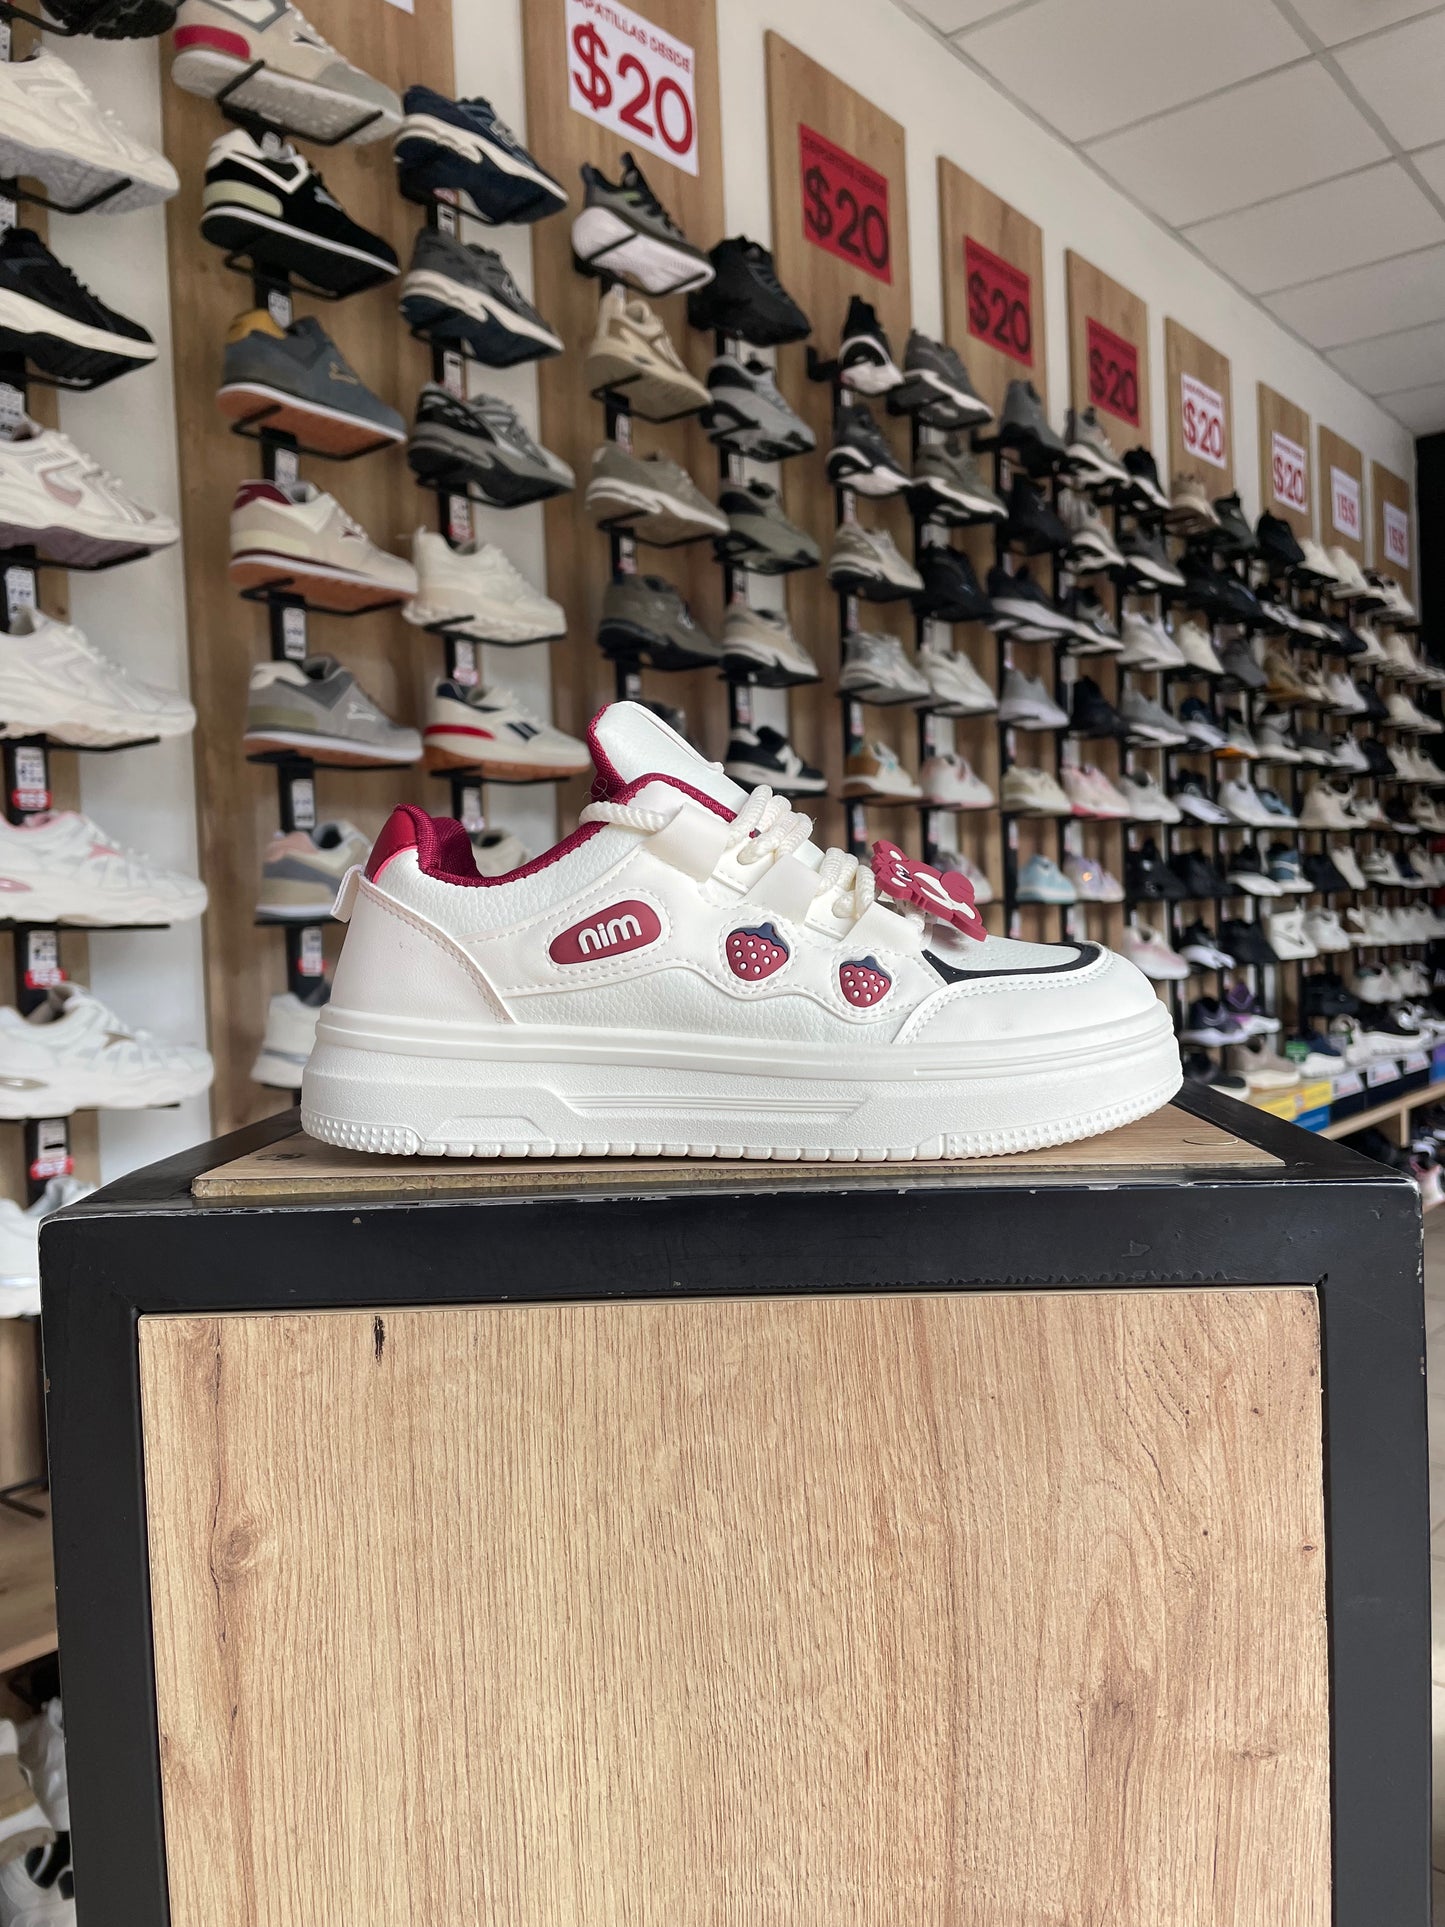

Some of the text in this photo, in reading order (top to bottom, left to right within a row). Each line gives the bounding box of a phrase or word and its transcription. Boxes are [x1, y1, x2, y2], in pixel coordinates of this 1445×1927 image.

[572, 21, 693, 155] $20
[805, 166, 889, 270] $20
[968, 271, 1031, 354] $20
[1089, 348, 1138, 417] $20
[1183, 400, 1223, 459] $20
[1273, 456, 1304, 505] $20
[578, 914, 642, 955] nim
